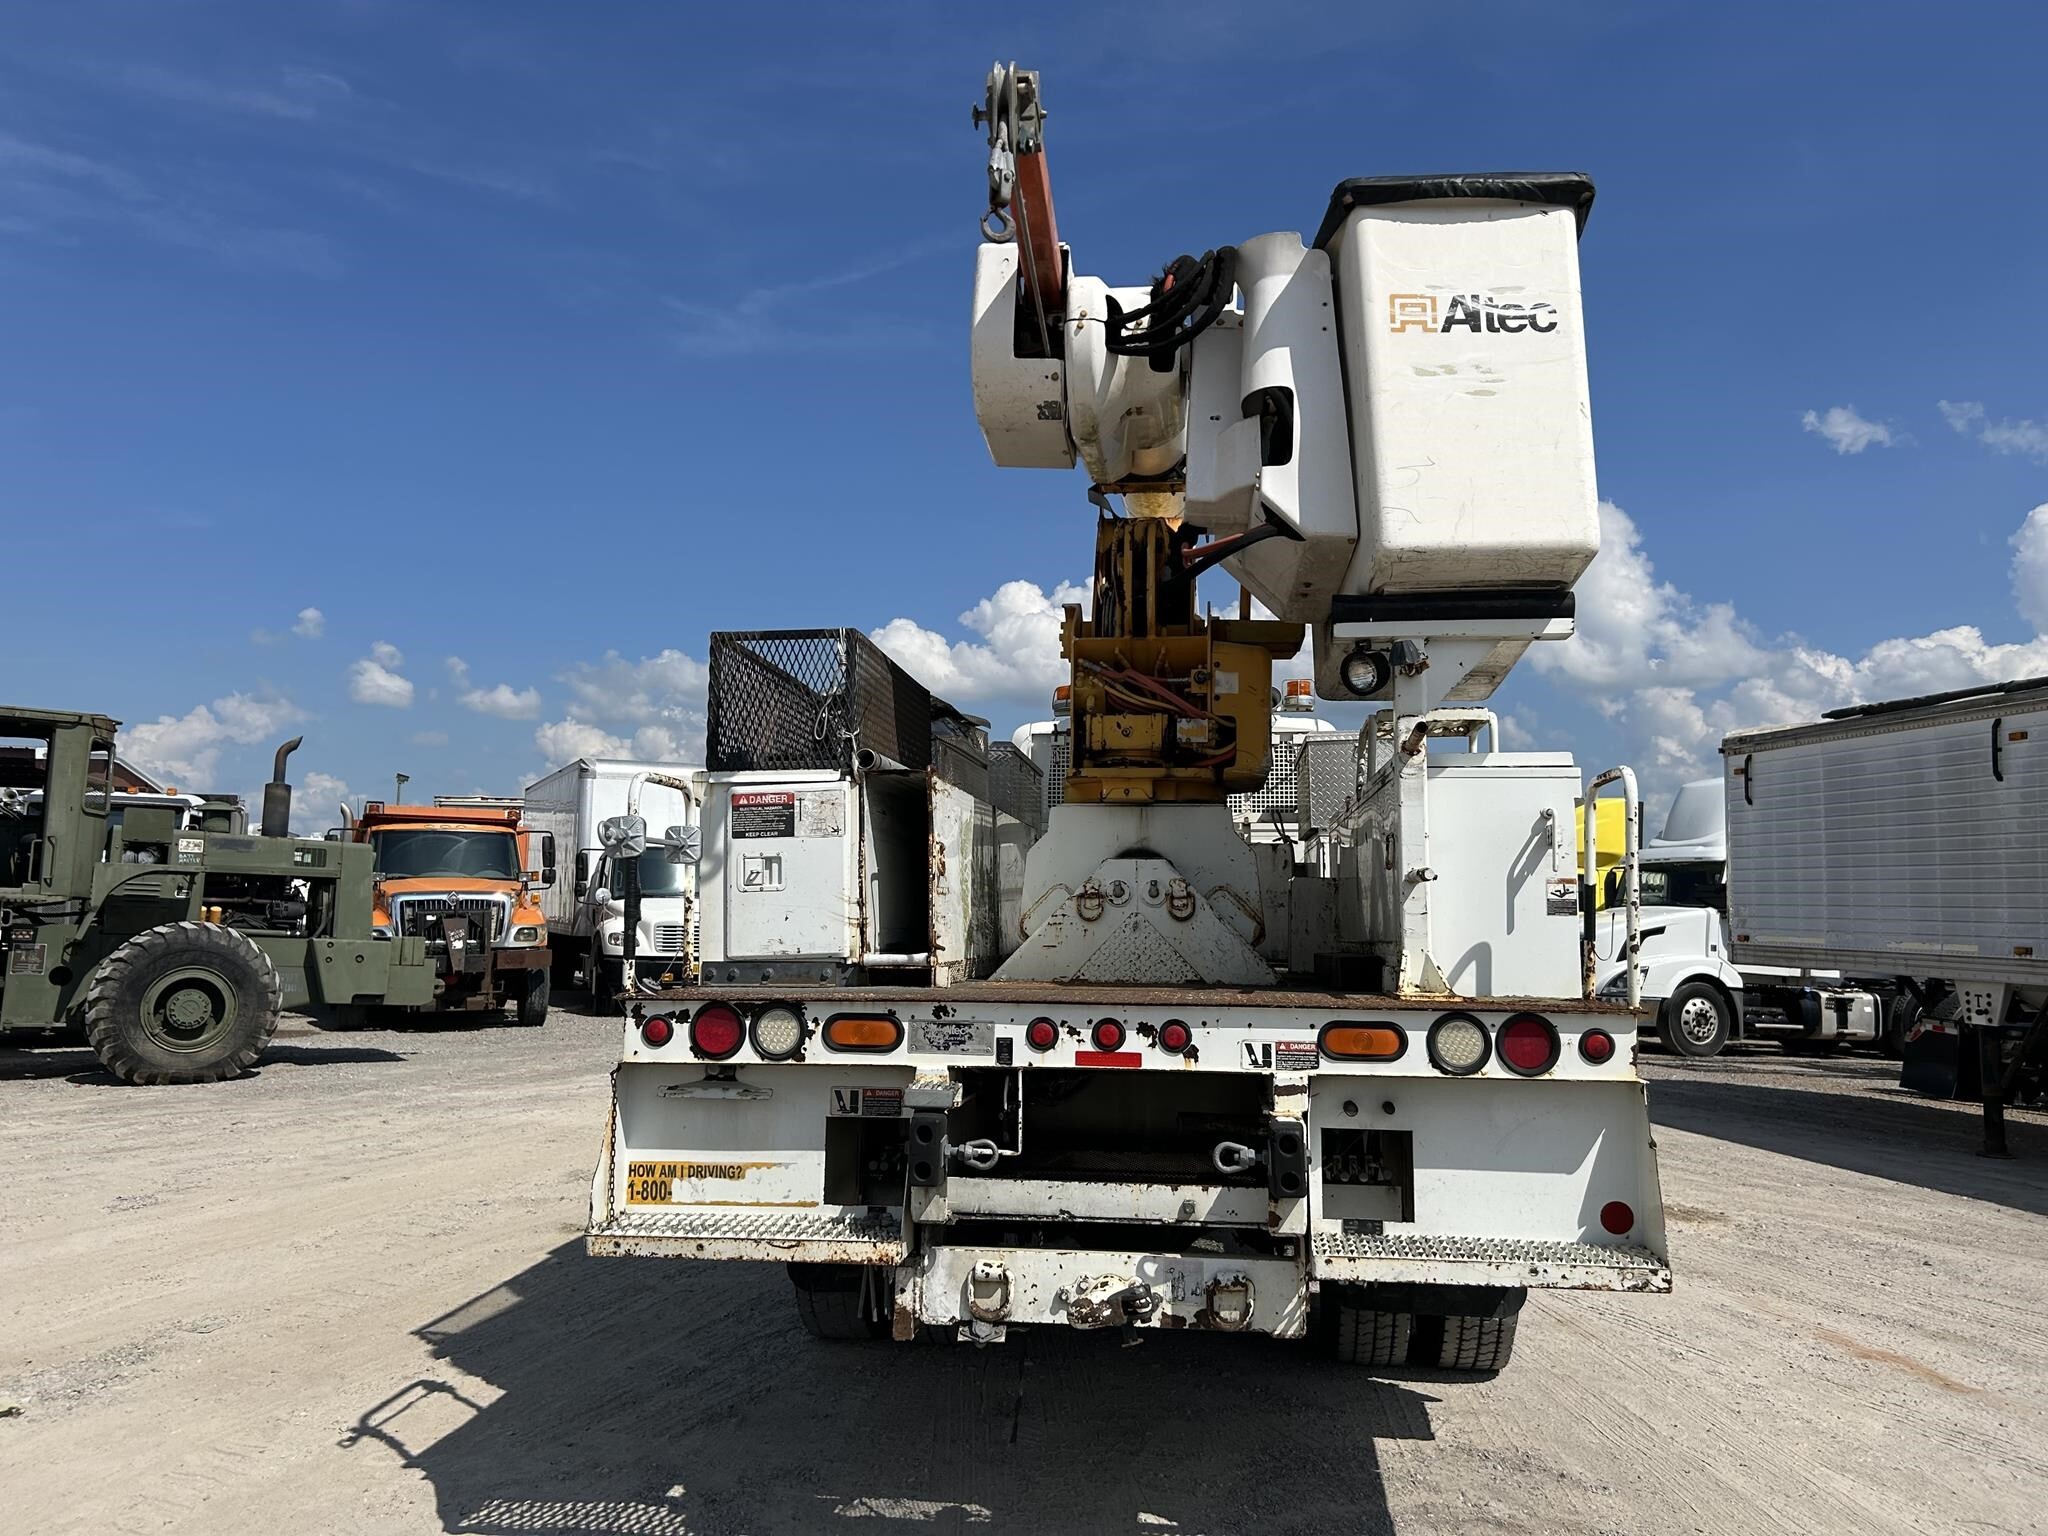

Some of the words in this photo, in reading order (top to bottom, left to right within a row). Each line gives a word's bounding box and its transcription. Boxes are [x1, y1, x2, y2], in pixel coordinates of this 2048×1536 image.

[1440, 294, 1558, 334] Altec
[749, 794, 788, 804] DANGER
[628, 1164, 656, 1178] HOW
[659, 1165, 677, 1178] AM
[680, 1165, 684, 1178] I
[687, 1165, 742, 1179] DRIVING?
[628, 1180, 672, 1201] 1-800-
